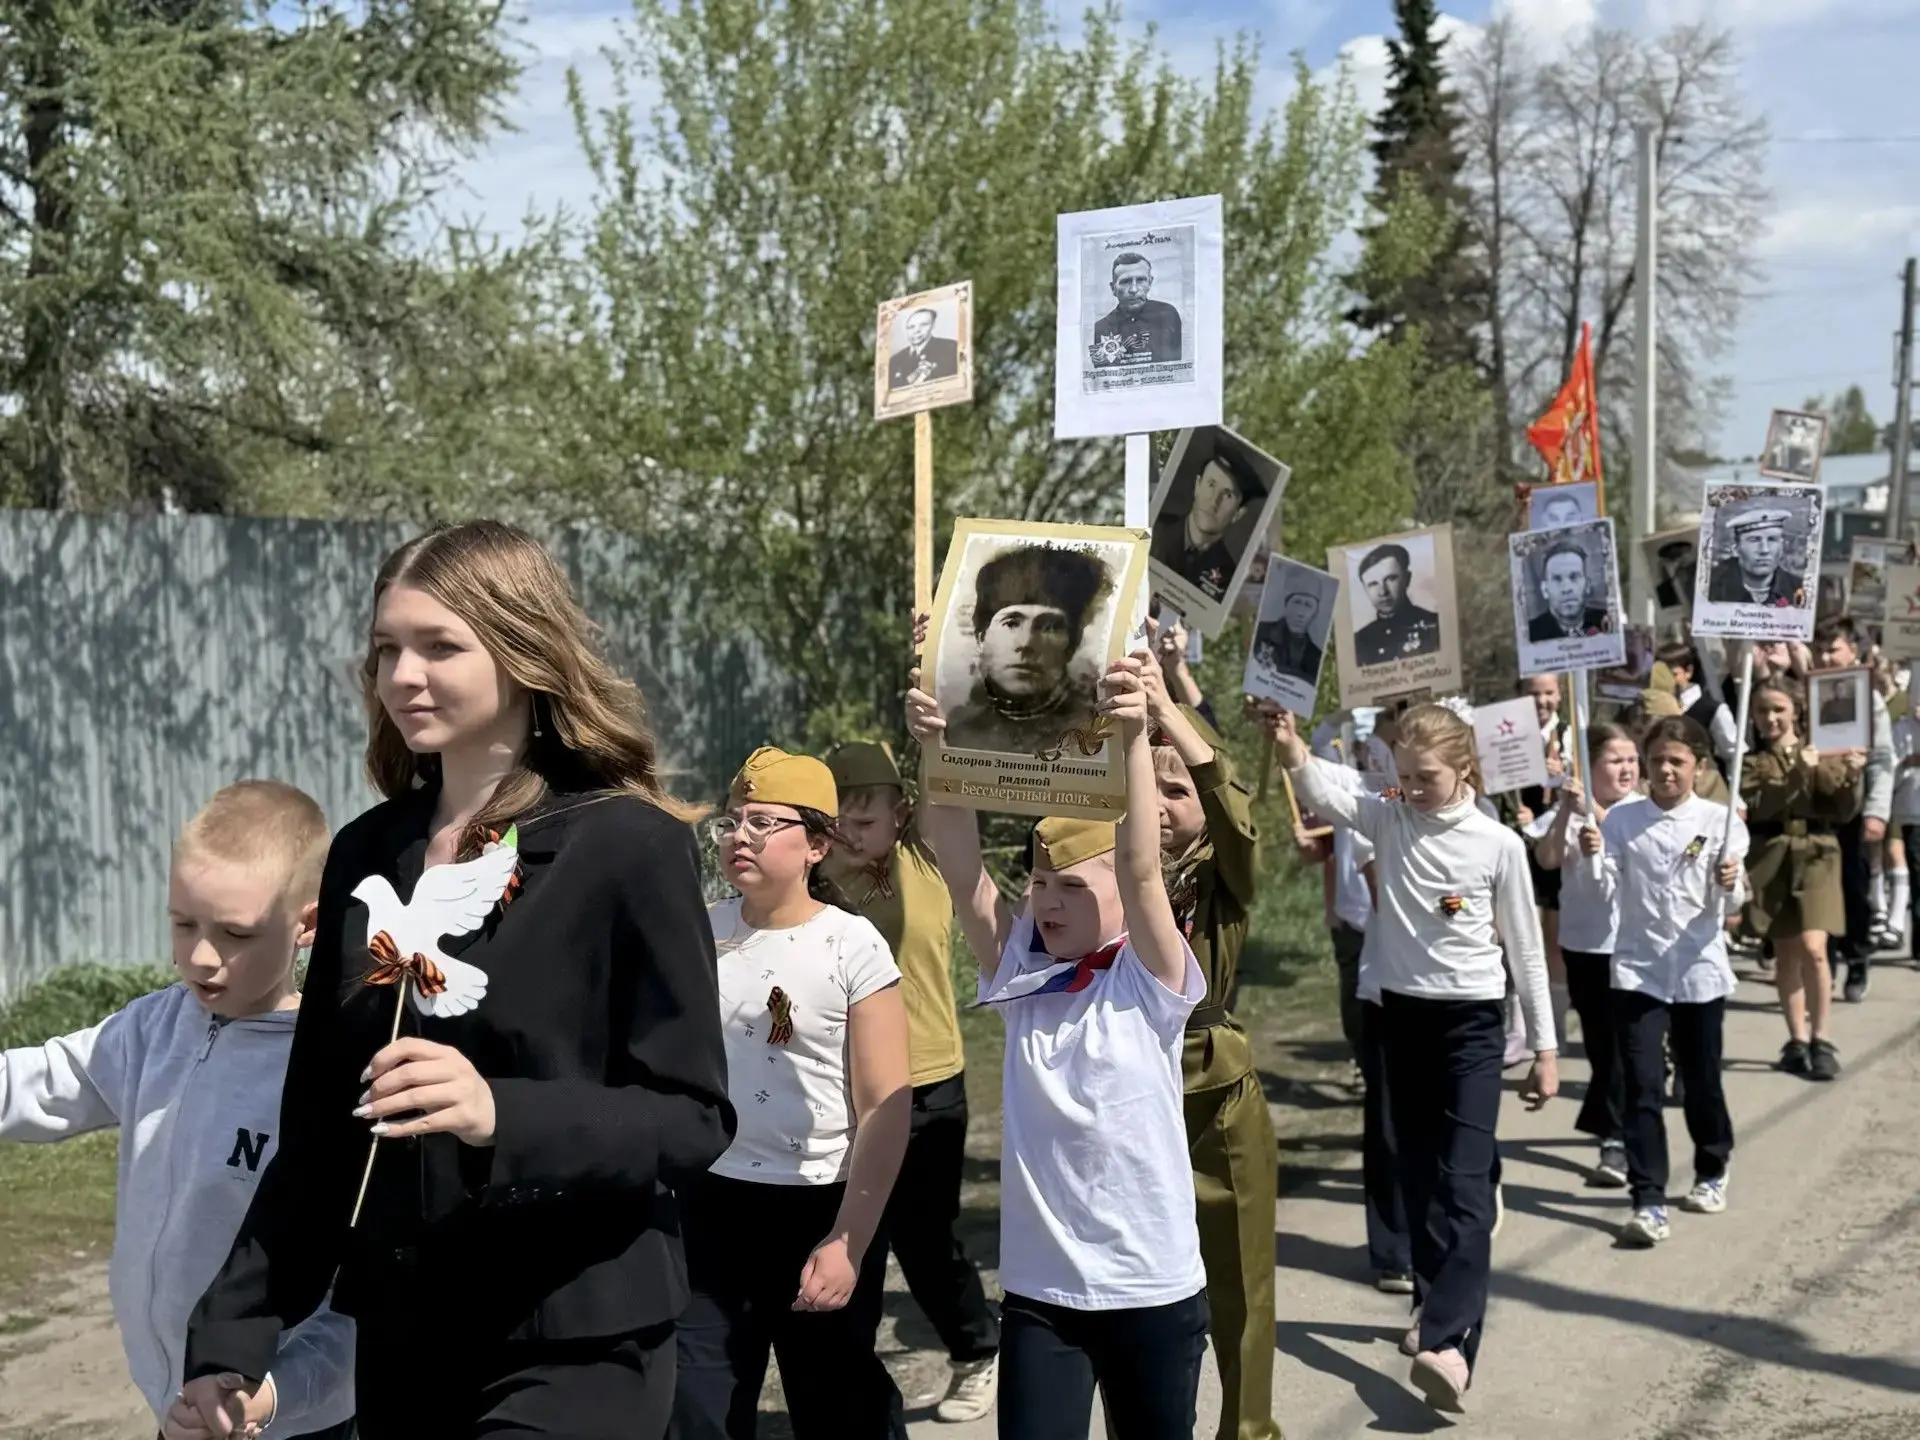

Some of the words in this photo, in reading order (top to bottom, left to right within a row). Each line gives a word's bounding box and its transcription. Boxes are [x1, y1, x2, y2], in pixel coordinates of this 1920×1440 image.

[1703, 618, 1727, 627] Иван
[1730, 619, 1804, 630] Митрофанович
[941, 753, 992, 768] Сидоров
[995, 759, 1048, 773] Зиновий
[1051, 764, 1107, 778] Ионович
[960, 780, 1052, 804] Бессмертный
[1055, 792, 1092, 806] полк
[998, 774, 1051, 787] рядовой
[226, 1127, 270, 1172] N
